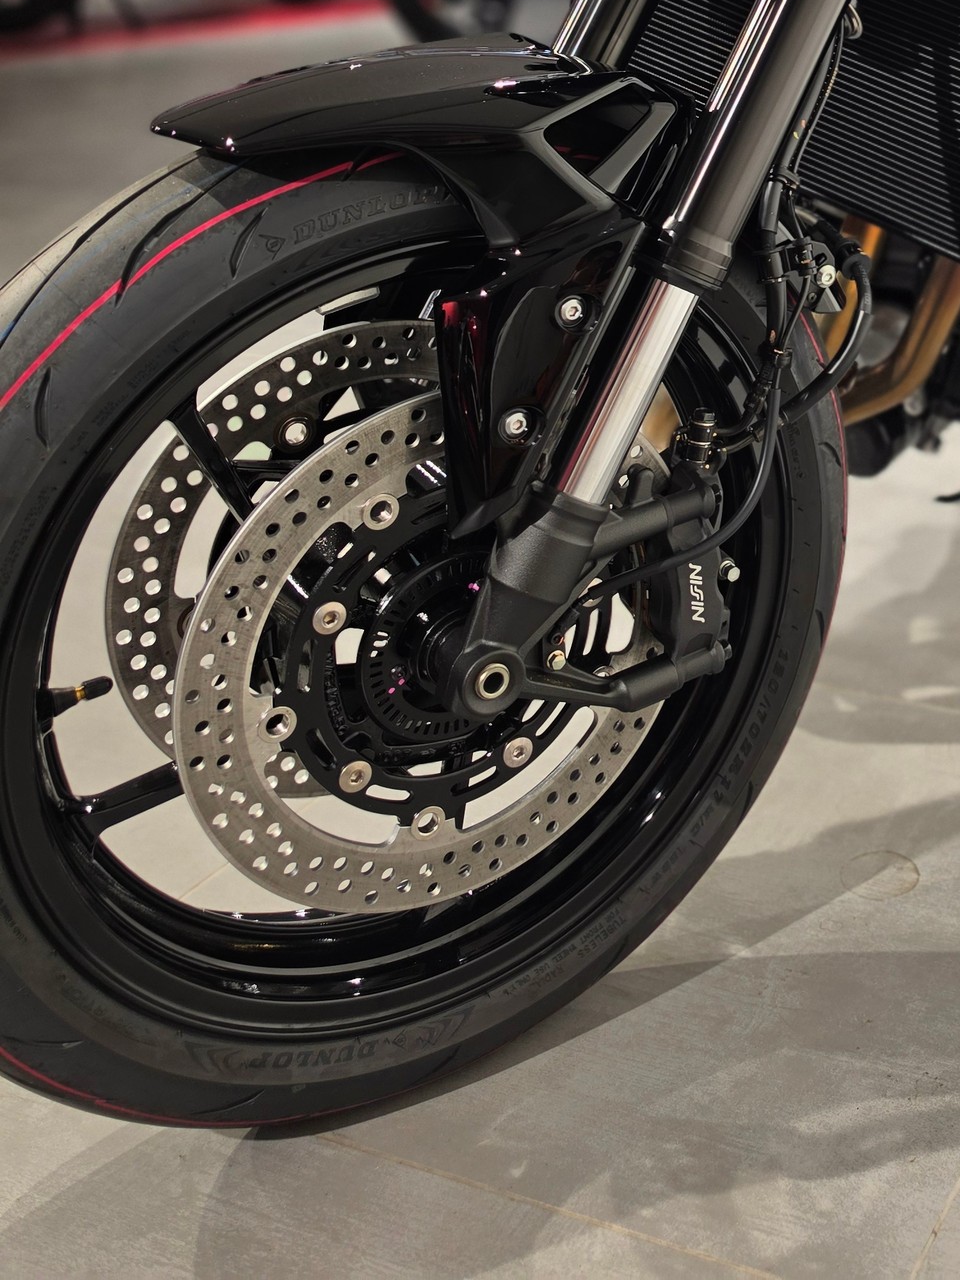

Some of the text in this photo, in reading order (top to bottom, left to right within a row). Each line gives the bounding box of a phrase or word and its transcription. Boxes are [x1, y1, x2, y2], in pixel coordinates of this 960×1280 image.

[293, 185, 440, 245] DUNLOP
[688, 562, 706, 623] NISSIN
[575, 914, 627, 960] TUBELESS
[249, 1040, 377, 1069] DUNLOP
